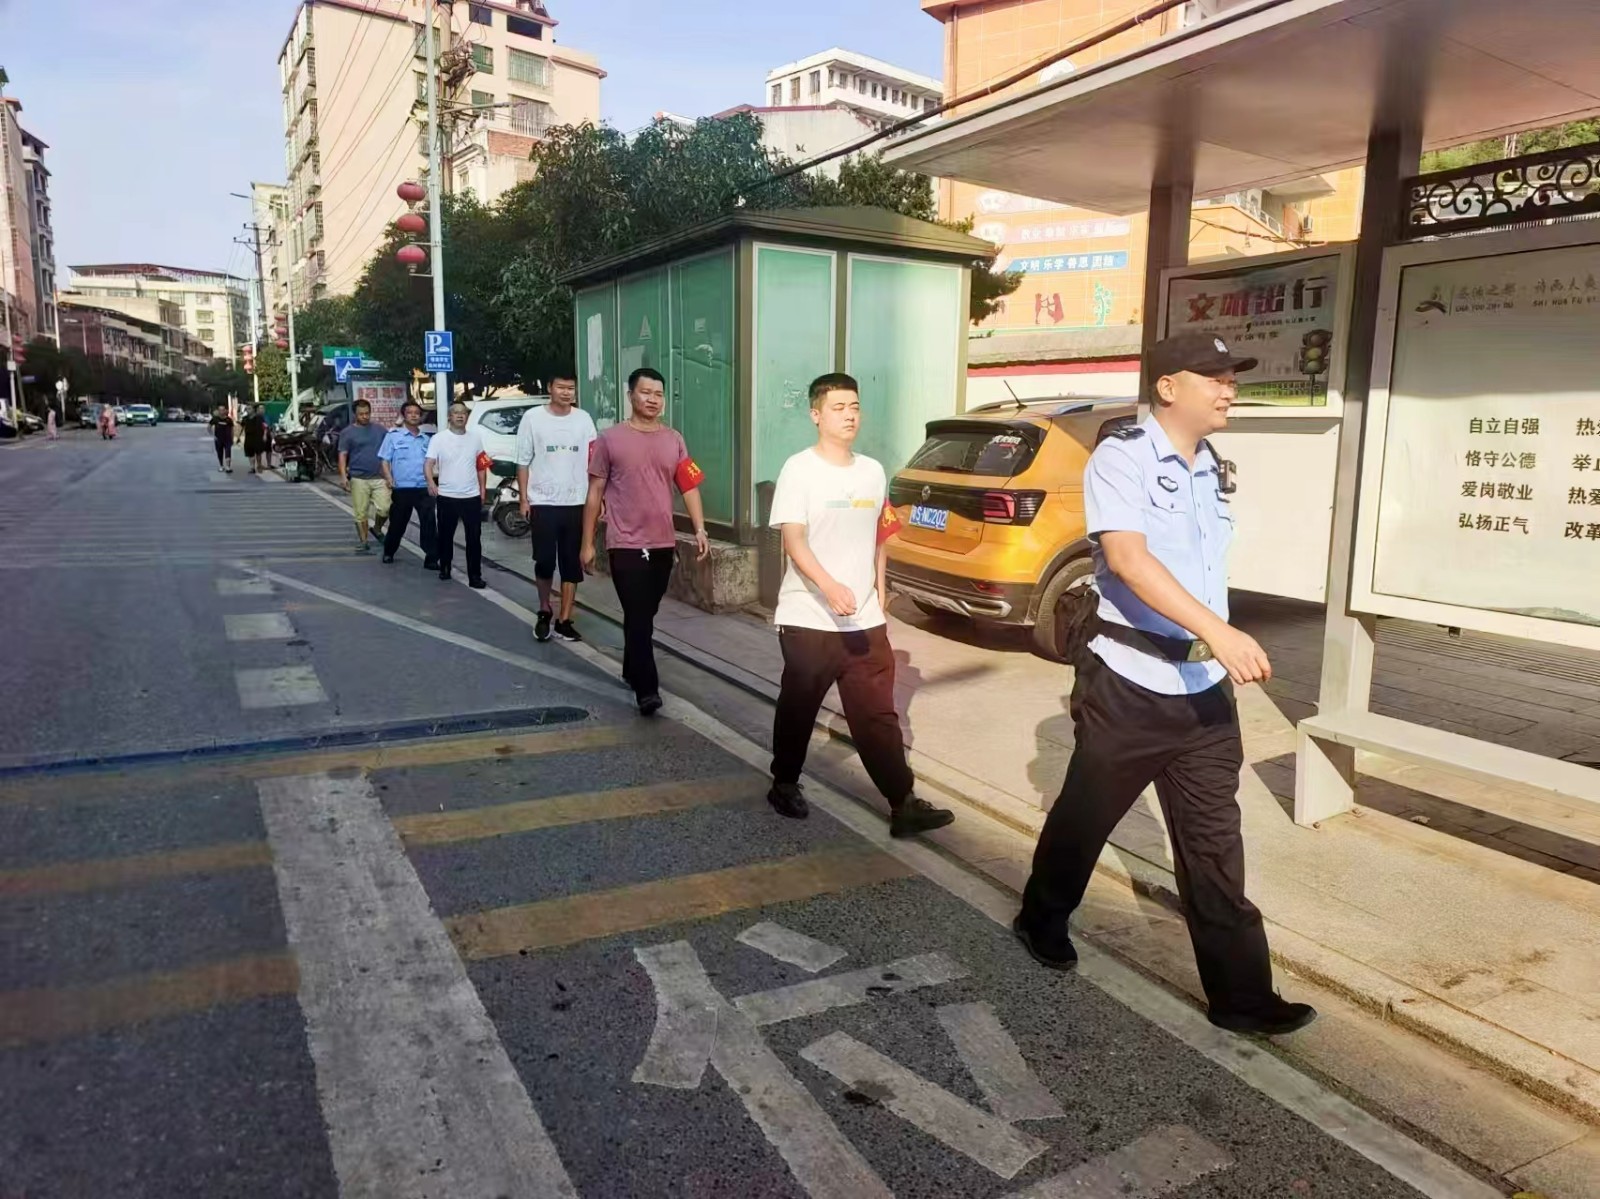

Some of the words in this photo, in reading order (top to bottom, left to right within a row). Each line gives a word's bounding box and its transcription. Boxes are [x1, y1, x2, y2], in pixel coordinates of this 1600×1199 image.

[1019, 259, 1040, 271] 文明
[428, 334, 442, 354] P
[1469, 417, 1540, 435] 自立自强
[1576, 417, 1600, 436] 热
[1465, 450, 1536, 469] 恪守公德
[1460, 481, 1533, 501] 爱岗敬业
[1458, 513, 1529, 535] 弘扬正气
[1564, 521, 1600, 541] 改革
